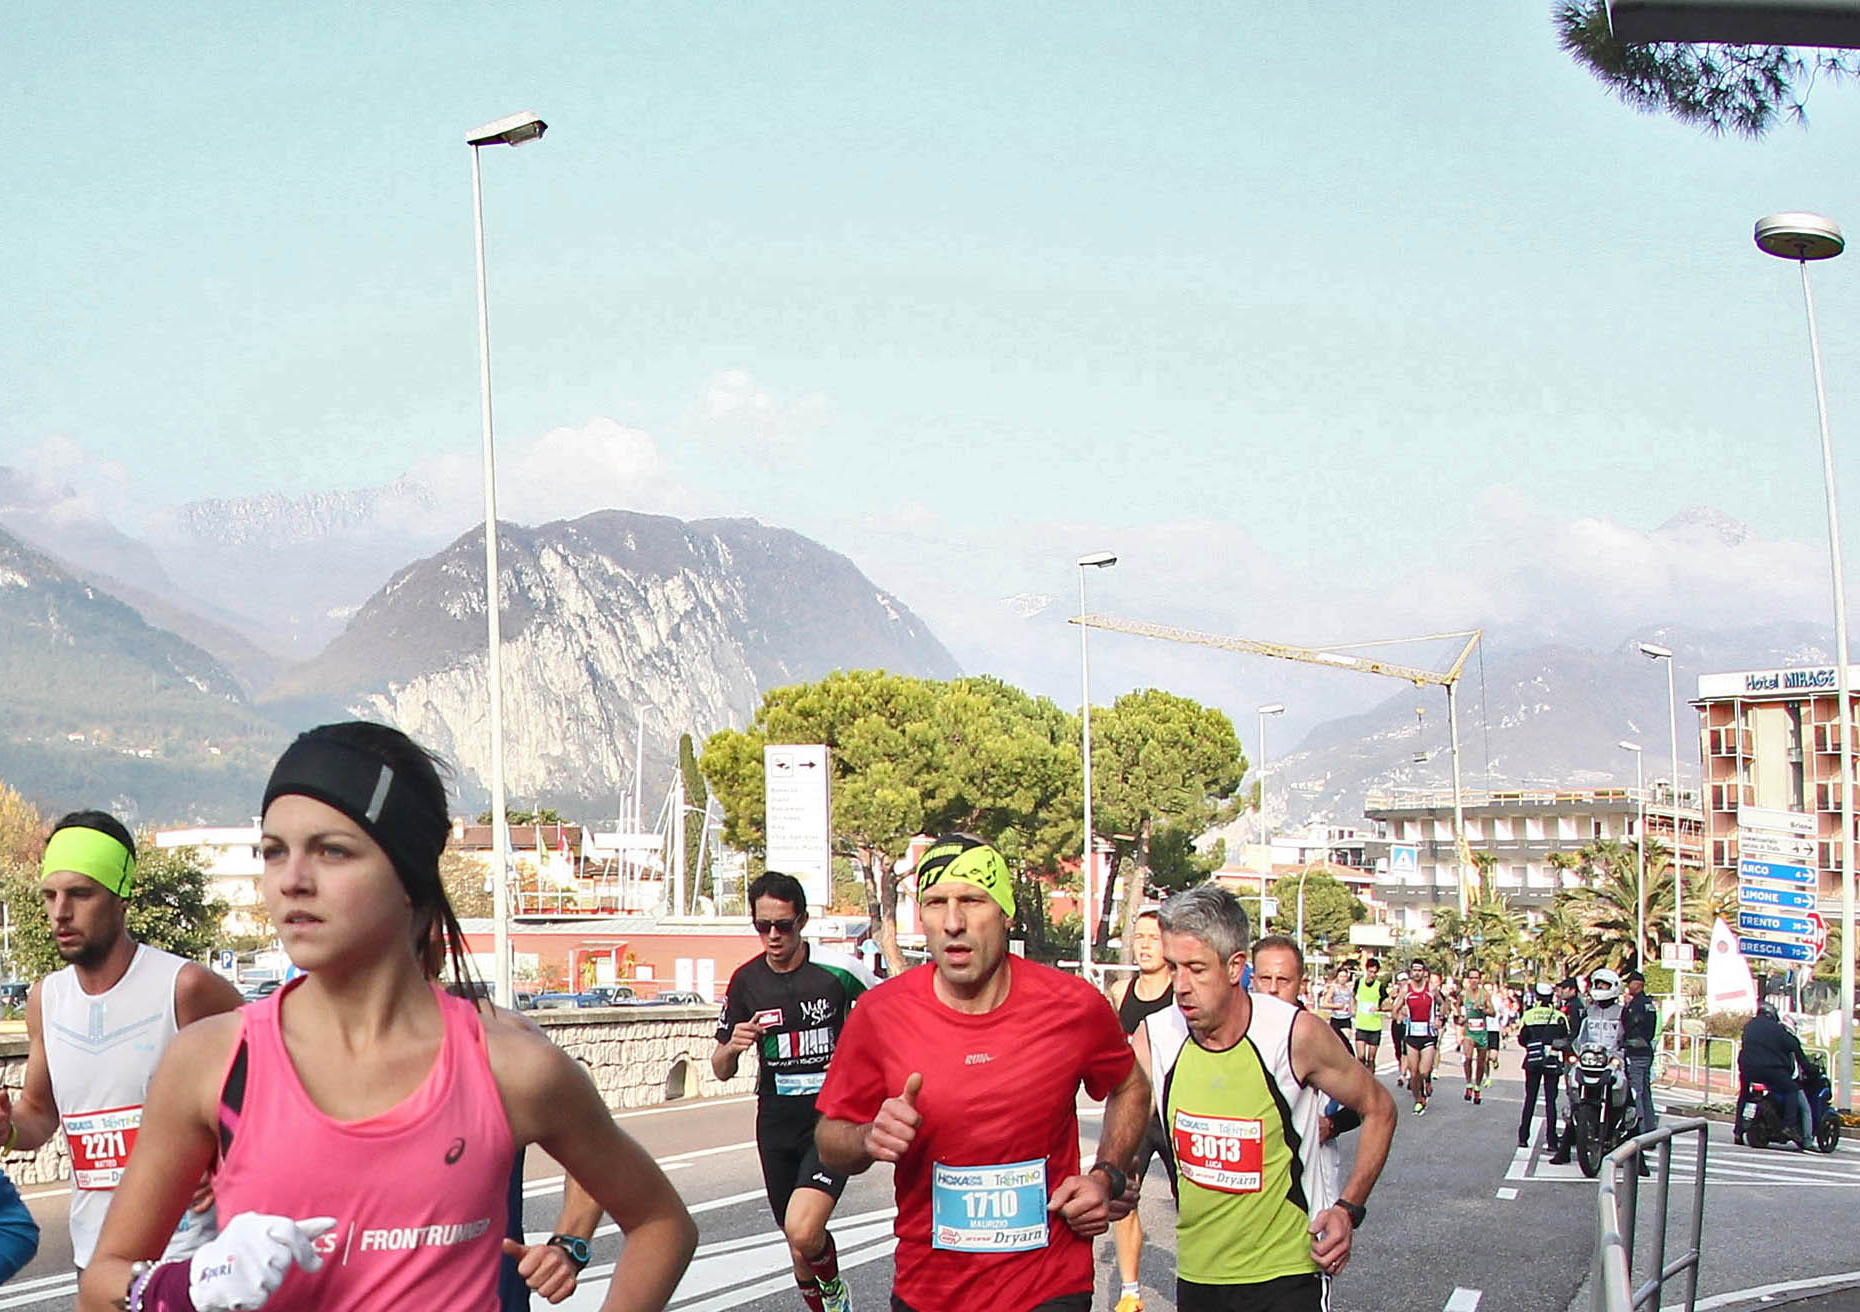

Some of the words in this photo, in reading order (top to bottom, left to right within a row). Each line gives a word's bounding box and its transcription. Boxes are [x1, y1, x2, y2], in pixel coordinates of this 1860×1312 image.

[1746, 673, 1779, 691] Hotel
[1784, 669, 1836, 689] MIRAGE
[1742, 863, 1770, 876] ARCO
[1741, 889, 1780, 903] LIMONE
[1741, 915, 1781, 929] TRENTO
[1741, 942, 1783, 955] BRESCIA
[223, 952, 232, 967] P
[81, 1131, 127, 1160] 2271
[1190, 1134, 1241, 1163] 3013
[1205, 1160, 1223, 1169] LUCA
[994, 1169, 1041, 1187] TRENTINO
[1216, 1172, 1257, 1187] Dryarn
[961, 1189, 1019, 1218] 1710
[360, 1218, 491, 1252] FRONTRUNNER
[993, 1230, 1042, 1247] Dryarn
